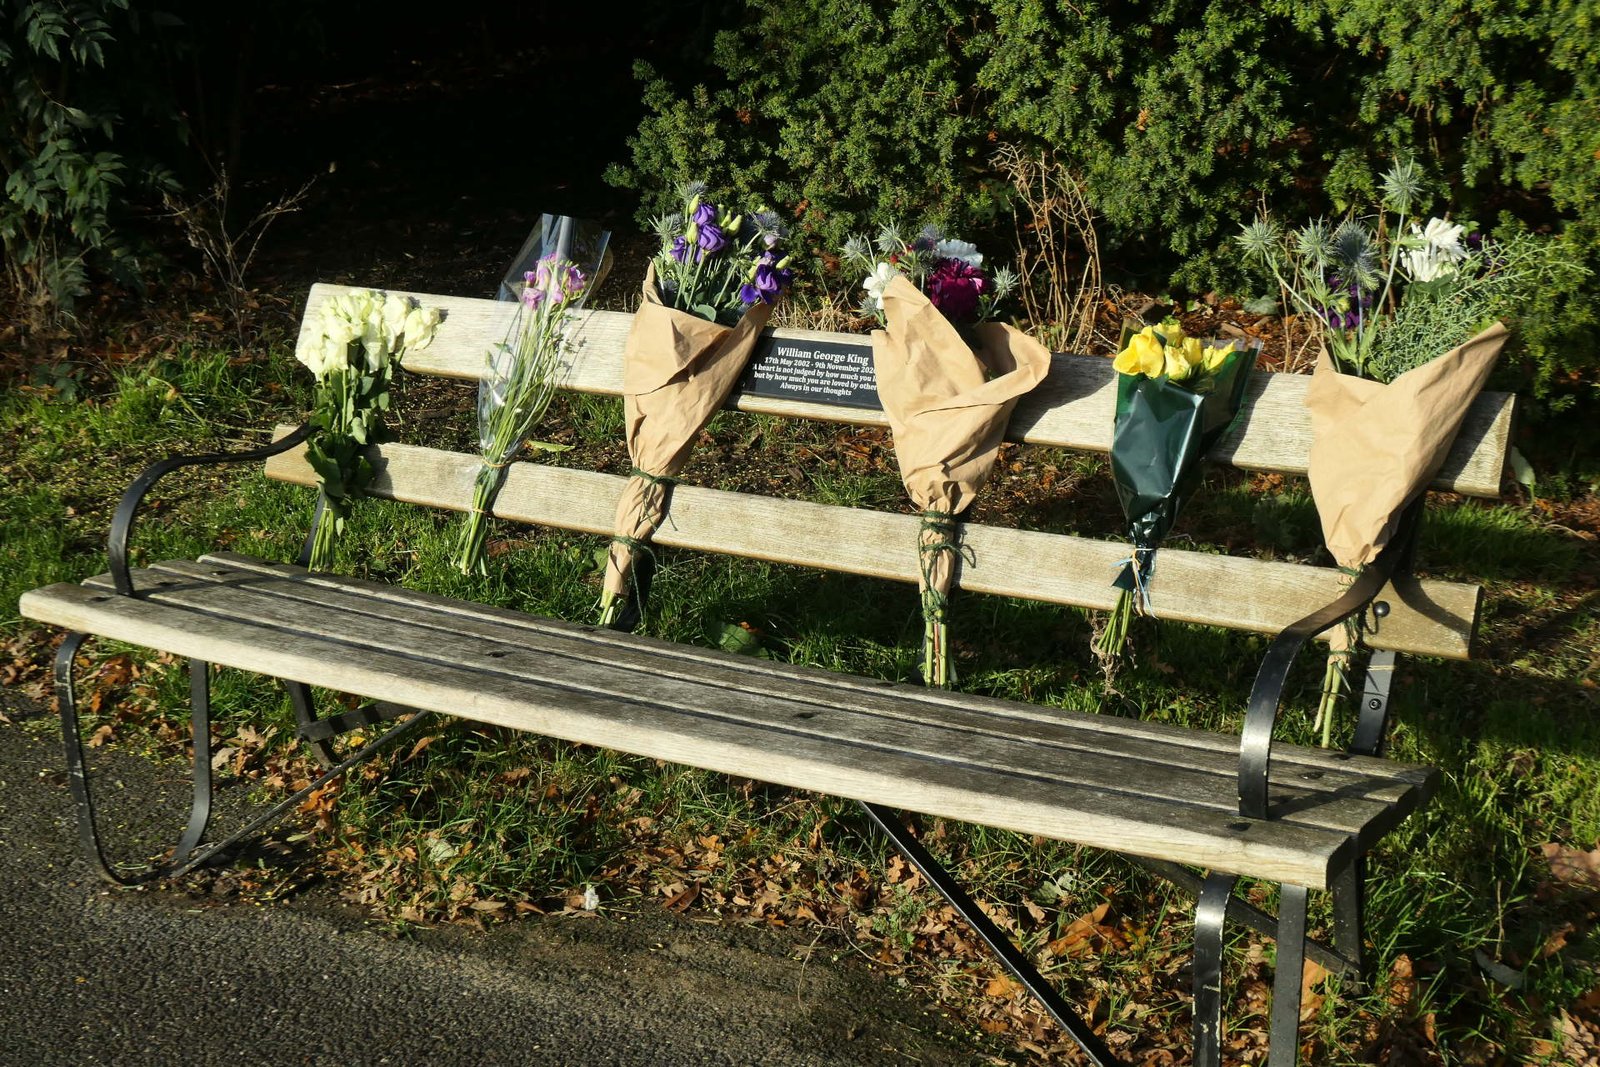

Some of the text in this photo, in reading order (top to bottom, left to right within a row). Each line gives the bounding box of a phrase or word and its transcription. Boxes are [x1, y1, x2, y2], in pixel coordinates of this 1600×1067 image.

[777, 347, 869, 366] William George King
[780, 358, 794, 367] May
[827, 363, 860, 372] November
[794, 368, 815, 376] judged
[817, 370, 825, 378] by
[780, 383, 802, 391] Always
[823, 387, 852, 396] thoughts
[832, 380, 850, 388] loved
